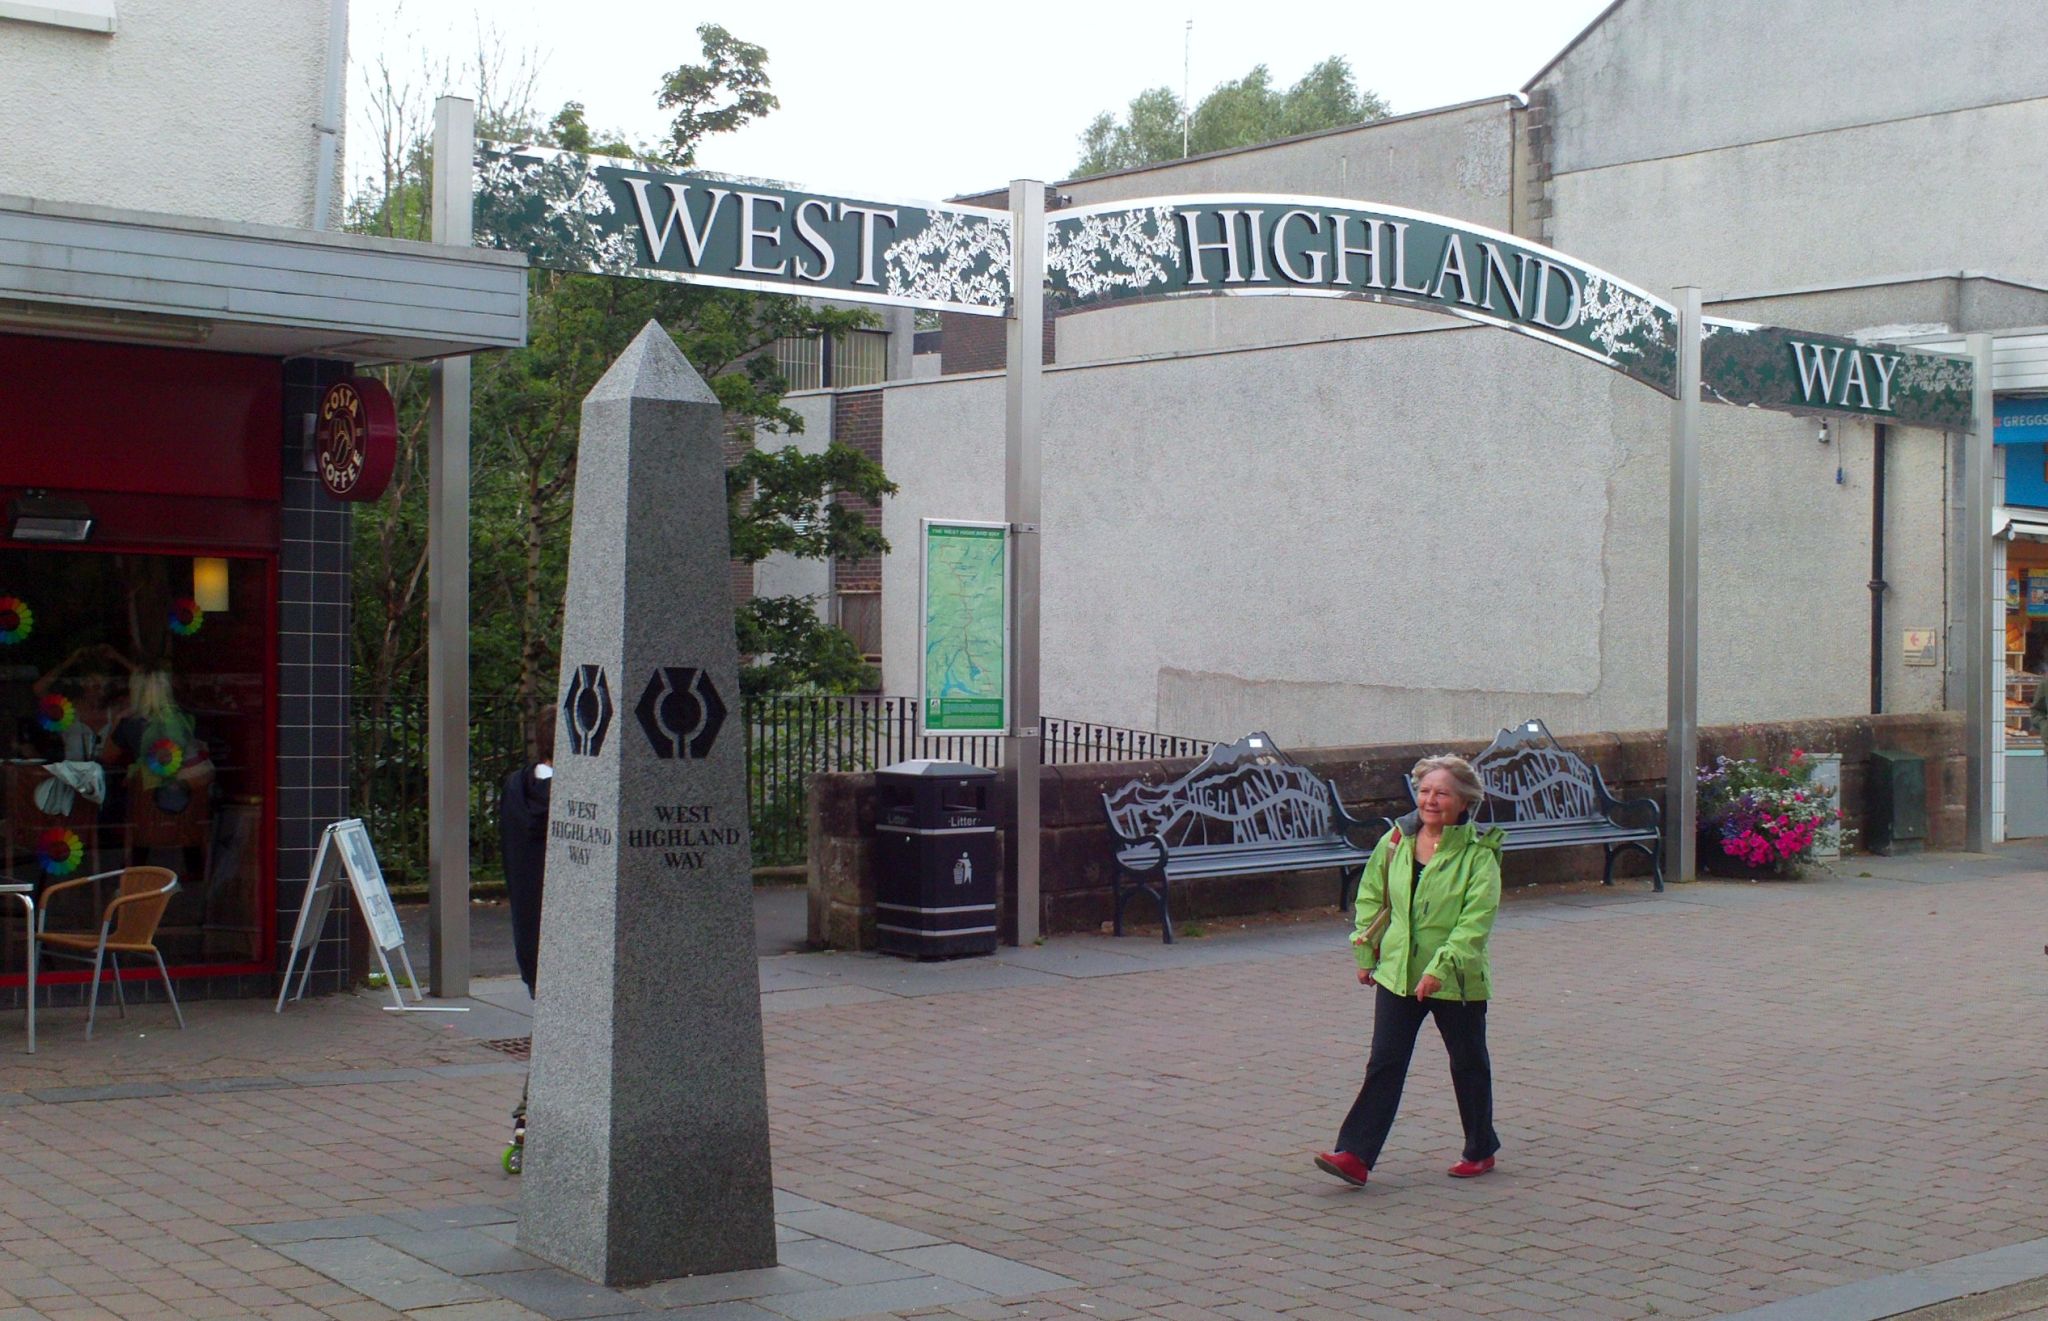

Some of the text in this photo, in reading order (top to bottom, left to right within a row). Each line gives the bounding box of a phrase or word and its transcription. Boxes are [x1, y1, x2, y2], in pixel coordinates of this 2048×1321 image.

[622, 177, 1901, 412] WEST HIGHLAND WAY
[324, 387, 359, 420] COSTA
[2003, 414, 2048, 427] GREGGS
[321, 449, 362, 489] COFFEE
[1186, 768, 1289, 816] HIGHLAND
[567, 799, 599, 821] WEST
[655, 805, 713, 824] WEST
[951, 816, 977, 827] Litter
[551, 820, 613, 846] HIGHLAND
[628, 827, 740, 849] HIGHLAND
[568, 845, 593, 866] WAY
[664, 851, 706, 870] WAY
